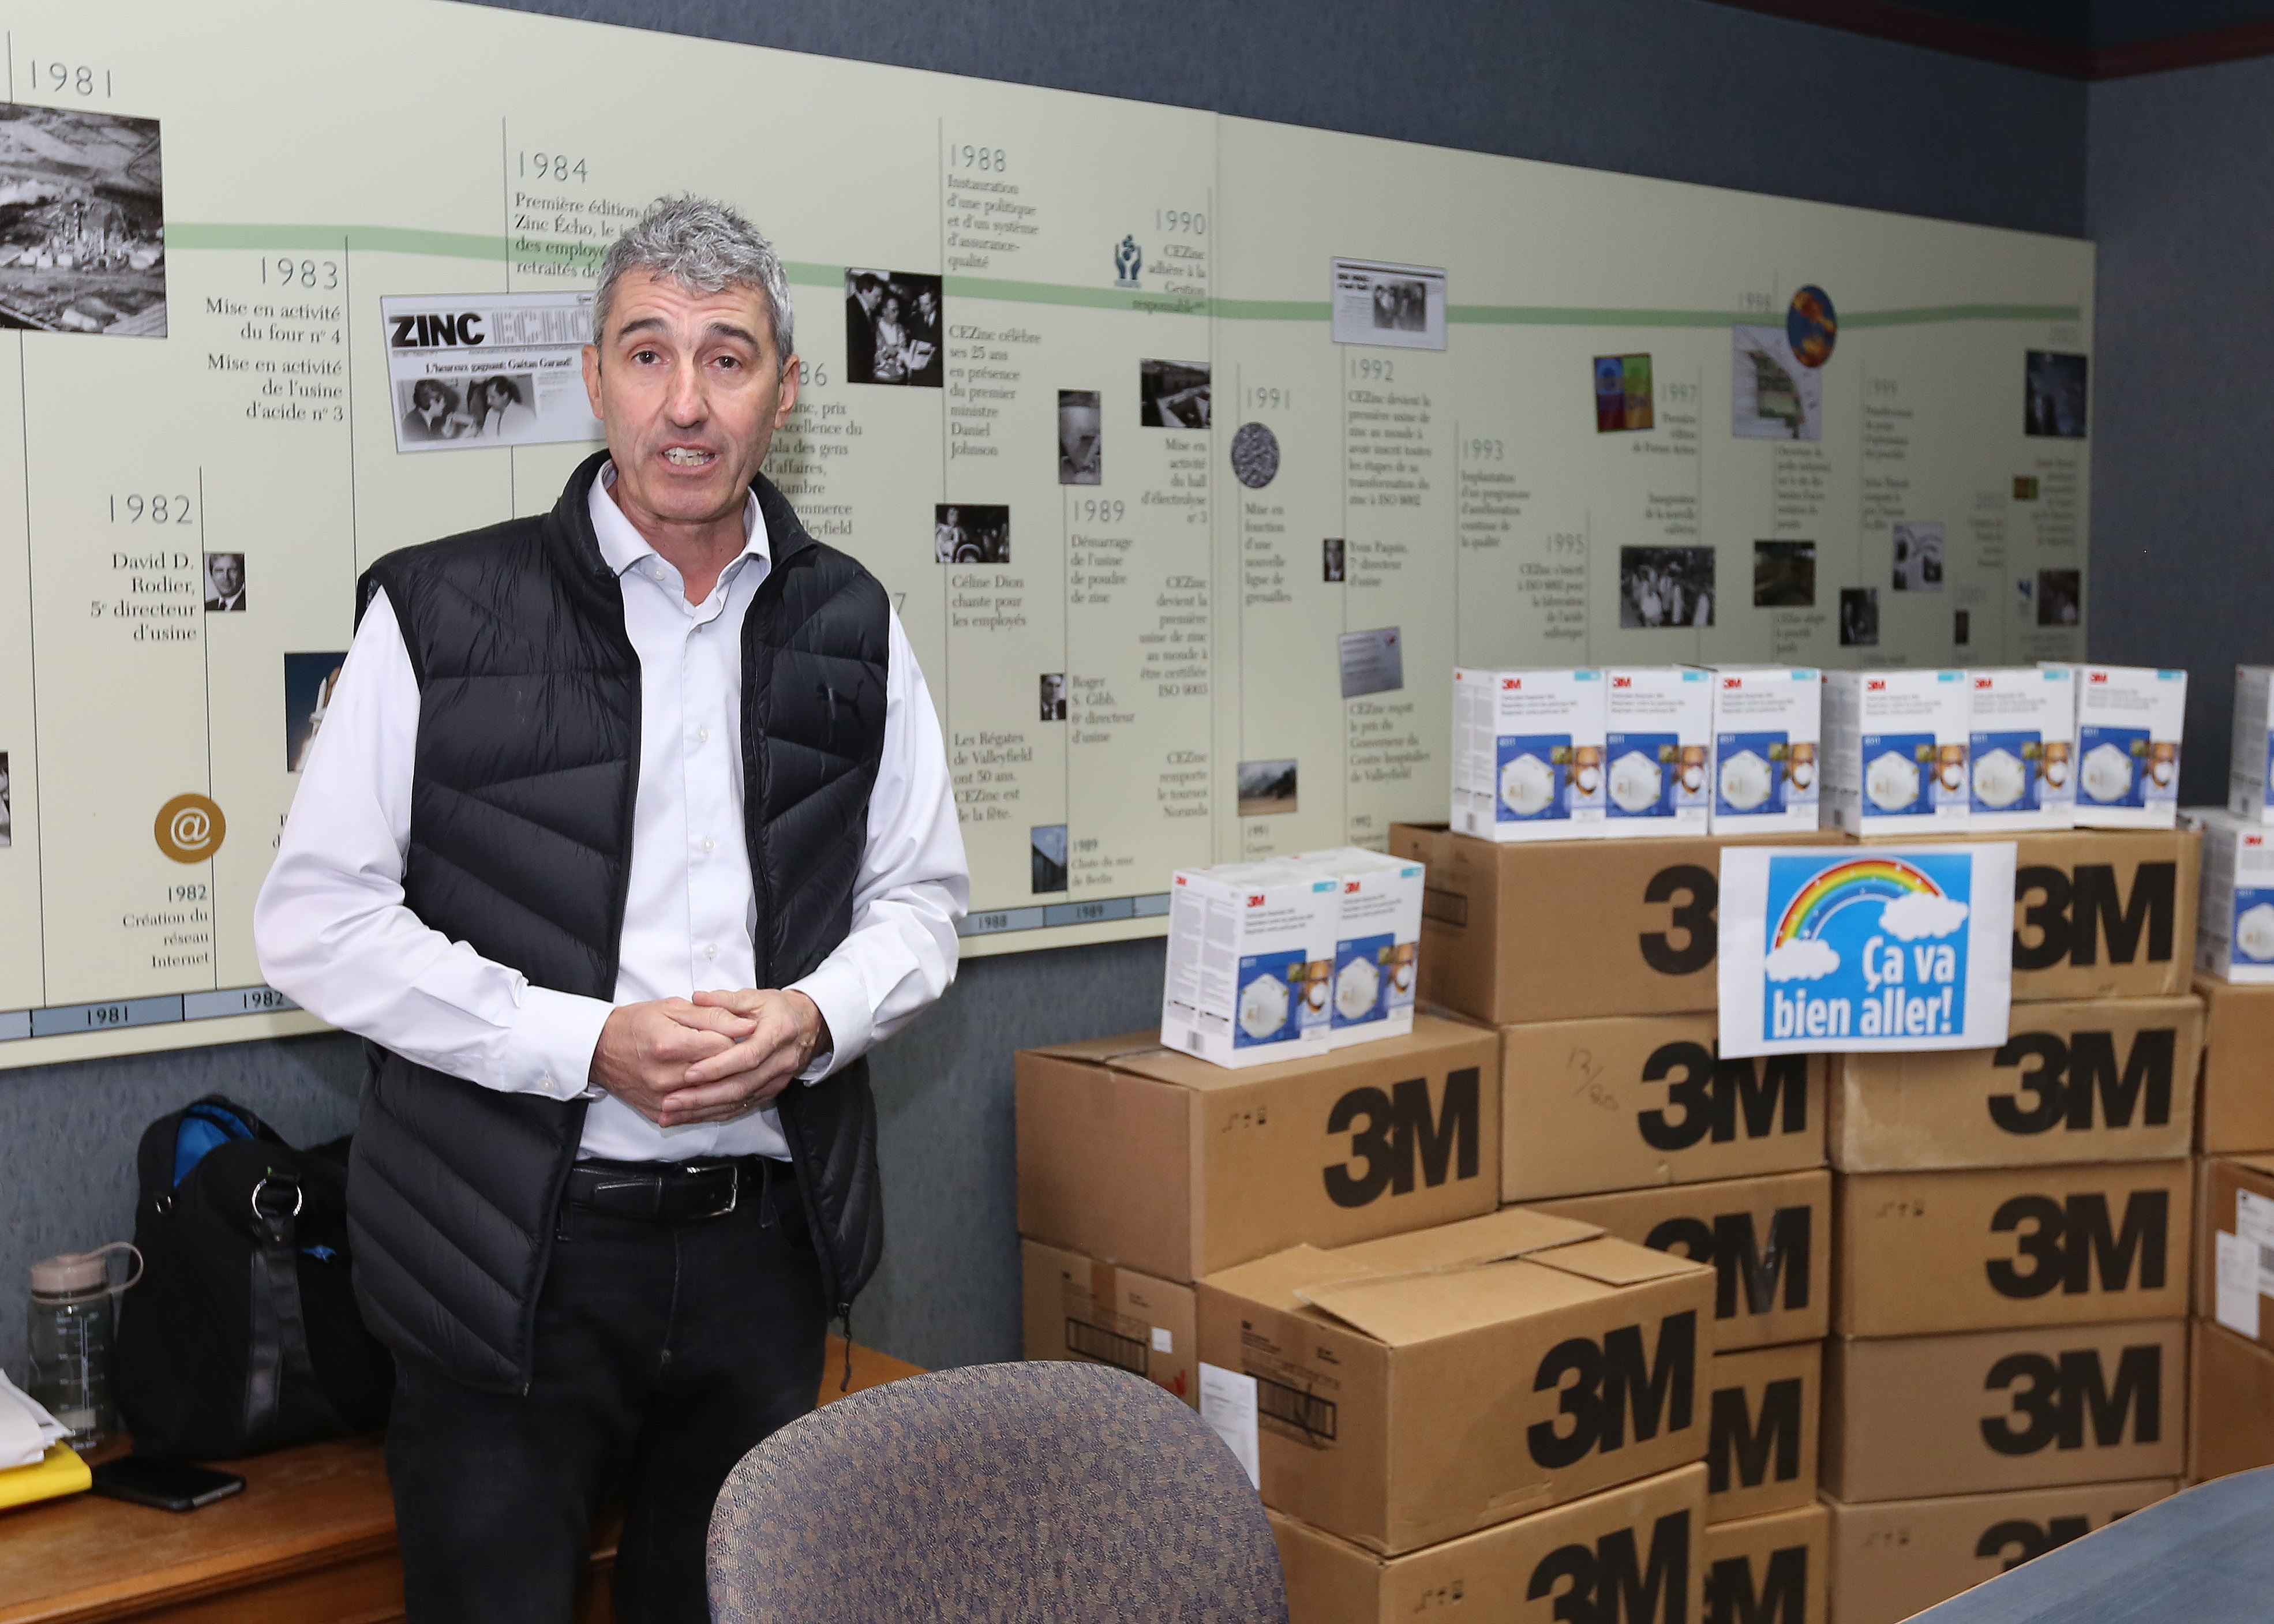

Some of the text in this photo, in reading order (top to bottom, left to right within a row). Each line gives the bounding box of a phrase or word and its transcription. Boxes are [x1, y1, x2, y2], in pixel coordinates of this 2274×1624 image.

[31, 59, 113, 98] 1981
[519, 151, 588, 183] 1984
[951, 144, 1006, 172] 1988
[948, 174, 1019, 194] Instauration
[515, 192, 638, 218] Première édition
[515, 214, 549, 230] Zinc
[555, 214, 595, 239] Écho,
[601, 220, 615, 237] le
[948, 217, 959, 227] et
[1156, 209, 1207, 235] 1990
[516, 237, 606, 264] des employé
[261, 256, 339, 290] 1983
[516, 262, 578, 279] retraités
[205, 297, 340, 322] Mise en activité
[240, 321, 264, 341] du
[269, 322, 305, 343] four
[331, 330, 341, 344] 4
[389, 313, 485, 347] ZINC
[950, 346, 1008, 360] ses 25 ans
[208, 354, 342, 376] Mise en activité
[799, 361, 826, 386] 86
[950, 368, 964, 378] en
[1350, 358, 1394, 382] 1992
[262, 379, 342, 399] de l'usine
[950, 384, 965, 397] du
[1247, 386, 1290, 410] 1991
[246, 402, 307, 421] d'acide
[333, 406, 343, 422] 3
[822, 402, 847, 418] prix
[951, 405, 999, 418] ministre
[846, 421, 863, 435] du
[951, 423, 991, 436] Daniel
[794, 438, 849, 457] des gens
[951, 440, 999, 457] Johnson
[1462, 438, 1504, 462] 1993
[763, 459, 827, 476] d'affaires,
[774, 479, 826, 494] hambre
[110, 494, 193, 524] 1982
[792, 503, 853, 515] ommerce
[1074, 500, 1125, 523] 1989
[112, 552, 194, 571] David D.
[131, 576, 196, 596] Rodier,
[952, 575, 1025, 590] Céline Dion
[114, 599, 197, 618] directeur
[952, 594, 1022, 612] chante pour
[953, 613, 968, 626] les
[133, 623, 197, 642] d'usine
[1072, 676, 1105, 689] Roger
[1502, 678, 1522, 690] 3M
[1613, 676, 1632, 688] 3M
[1723, 677, 1742, 690] 3M
[1867, 679, 1886, 691] 3M
[1974, 677, 1993, 689] 3M
[2089, 673, 2108, 685] 3M
[1085, 711, 1134, 725] directeur
[954, 733, 975, 746] Les
[954, 751, 969, 766] de
[2245, 835, 2262, 846] 3M
[168, 885, 208, 903] 1982
[1344, 882, 1361, 894] 3M
[1247, 895, 1265, 907] 3M
[122, 908, 208, 928] Création du
[977, 914, 1007, 928] 1988
[1639, 864, 1718, 976] 3
[2012, 861, 2176, 972] 3M
[164, 932, 209, 947] réseau
[152, 952, 209, 969] Internet
[1861, 935, 1956, 993] Ça va
[243, 991, 285, 1010] 1982
[87, 1005, 129, 1026] 1981
[1772, 984, 1953, 1039] bien aller!
[1988, 1027, 2176, 1137] 3M
[1638, 1038, 1808, 1152] 3M
[1323, 1067, 1480, 1209] 3M
[1985, 1188, 2170, 1300] 3M
[1527, 1309, 1698, 1469] 3M
[1979, 1342, 2163, 1458] 3M
[1526, 1507, 1691, 1624] 3M
